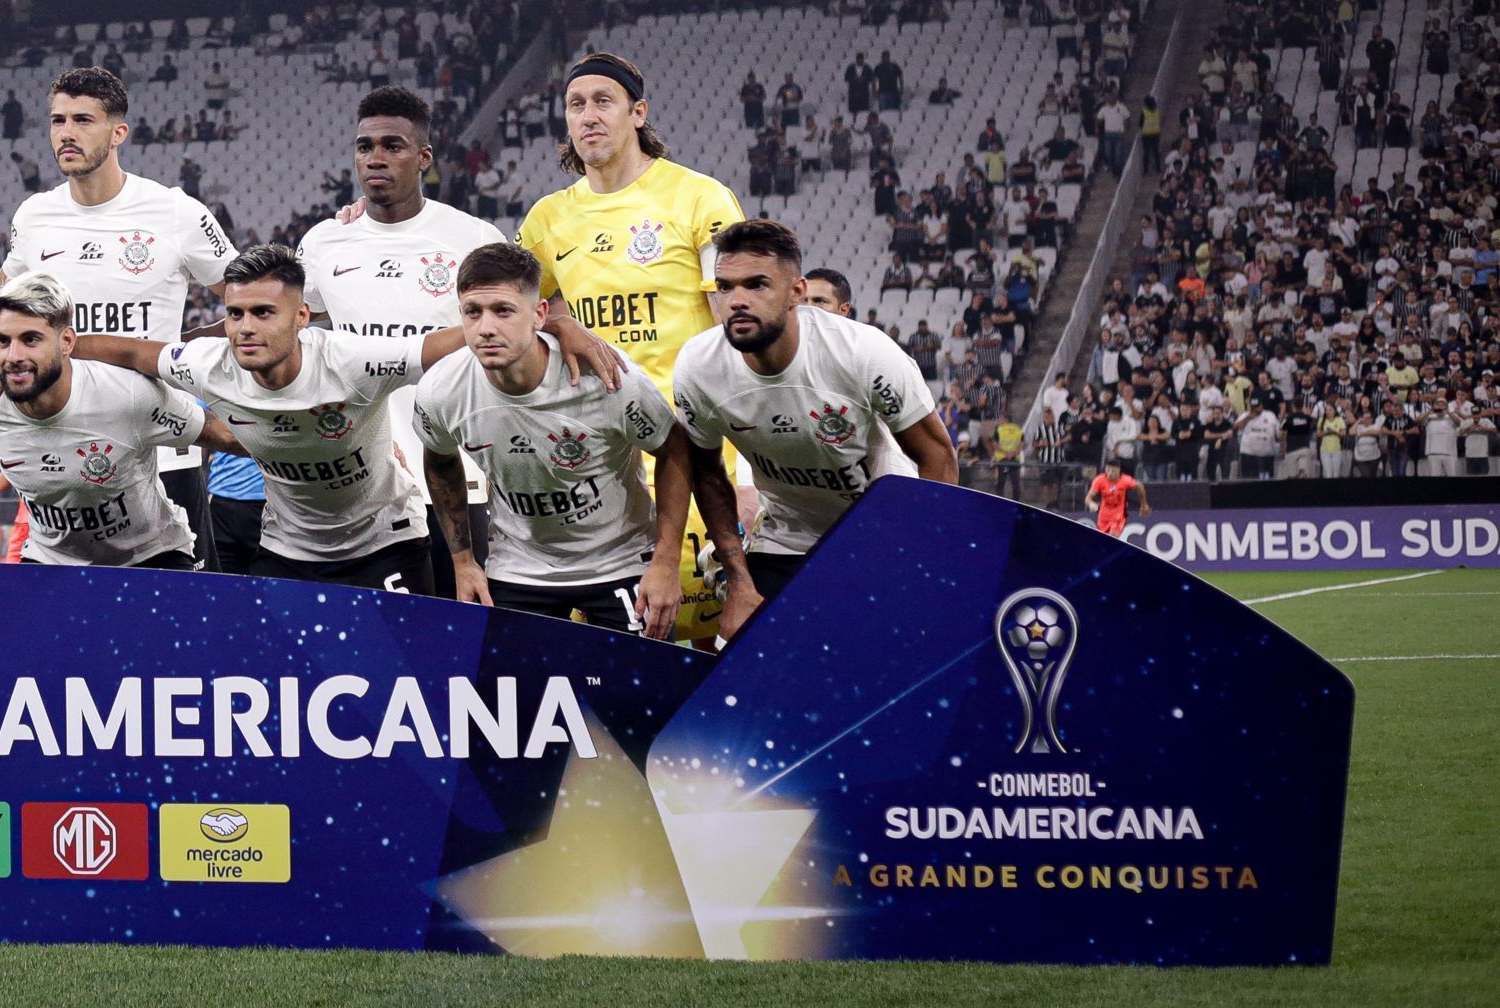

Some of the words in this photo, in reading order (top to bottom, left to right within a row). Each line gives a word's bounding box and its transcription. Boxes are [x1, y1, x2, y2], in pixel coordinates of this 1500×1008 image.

[206, 223, 228, 258] bmg
[591, 244, 614, 253] ALE
[79, 252, 104, 260] ALE
[74, 301, 152, 333] DEBET
[567, 292, 659, 329] AIDEBET
[615, 329, 658, 343] .COM
[157, 411, 187, 437] bmg
[272, 425, 301, 433] ALE
[628, 406, 655, 440] bmg
[771, 426, 800, 434] ALE
[40, 465, 66, 473] ALE
[324, 468, 370, 491] .COM
[560, 499, 604, 527] .COM
[90, 518, 132, 543] .COM
[1401, 518, 1500, 558] SUD
[990, 773, 1097, 798] CONMEBOL
[884, 806, 1205, 840] SUDAMERICANA
[59, 812, 111, 868] MG
[186, 846, 263, 863] mercado
[206, 862, 243, 879] livre
[832, 865, 852, 886] A
[870, 865, 1019, 889] GRANDE
[1036, 865, 1260, 893] CONQUISTA
